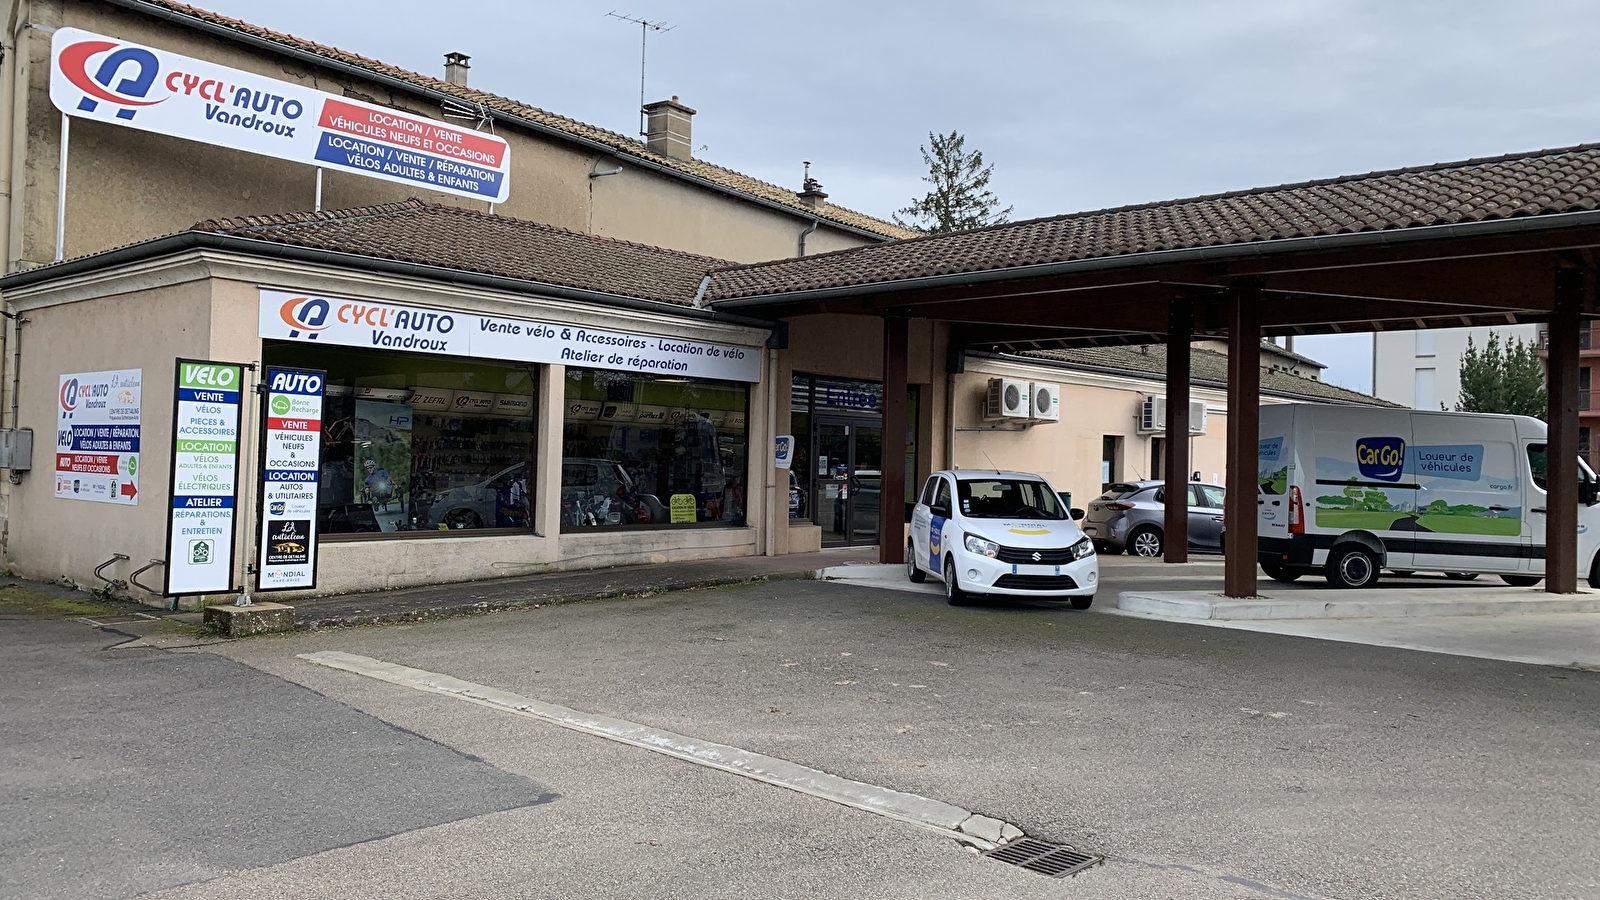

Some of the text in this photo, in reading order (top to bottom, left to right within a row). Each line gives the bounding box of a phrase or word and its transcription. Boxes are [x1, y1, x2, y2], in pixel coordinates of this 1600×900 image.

[165, 71, 304, 120] CYCL'AUTO
[205, 103, 295, 138] Vandroux
[369, 112, 423, 134] LOCATION
[433, 127, 463, 144] VENTE
[329, 115, 496, 165] VÉHICULES NEUFS ET OCCASIONS
[328, 135, 385, 158] LOCATION
[395, 150, 427, 167] VENTE
[436, 160, 495, 182] RÉPARATION
[346, 152, 480, 192] VÉLOS ADULTES & ENFANTS
[337, 303, 454, 334] CYCL'AUTO
[372, 329, 448, 352] Vandroux
[480, 318, 521, 336] Vente
[526, 319, 555, 339] vélo
[560, 328, 571, 341] &
[576, 330, 647, 350] Accessoires
[658, 339, 703, 356] Location
[706, 343, 720, 358] de
[723, 345, 745, 360] vélo
[560, 348, 689, 372] Atelier de réparation
[272, 373, 321, 393] AUTO
[194, 392, 224, 402] VENTE
[196, 404, 222, 414] VÉLOS
[291, 406, 319, 415] Recharge
[190, 418, 218, 426] PIECES
[281, 420, 308, 430] VENTE
[74, 428, 94, 437] LOCATION
[97, 428, 109, 438] VENTE
[179, 427, 235, 436] ACCESSOIRES
[274, 432, 314, 442] VÉHICULES
[80, 438, 92, 450] VÉLOS
[92, 441, 108, 450] ADULTES
[113, 441, 131, 451] ENFANTS
[181, 442, 232, 452] LOCATION
[74, 455, 94, 463] LOCATION
[96, 456, 108, 464] VENTE
[193, 454, 219, 463] VÉLOS
[1357, 442, 1404, 467] CarGo!
[1418, 451, 1474, 462] Loueur de
[72, 464, 83, 472] NEUFS
[88, 465, 111, 473] OCCASIONS
[269, 460, 315, 468] OCCASIONS
[1421, 461, 1472, 473] véhicules
[192, 473, 219, 482] VÉLOS
[268, 472, 315, 481] LOCATION
[178, 481, 231, 491] ÉLECTRIQUES
[1489, 483, 1513, 491] cargo.fr
[186, 498, 222, 507] ATELIER
[175, 509, 231, 518] RÉPARATIONS
[181, 527, 223, 535] ENTRETIEN
